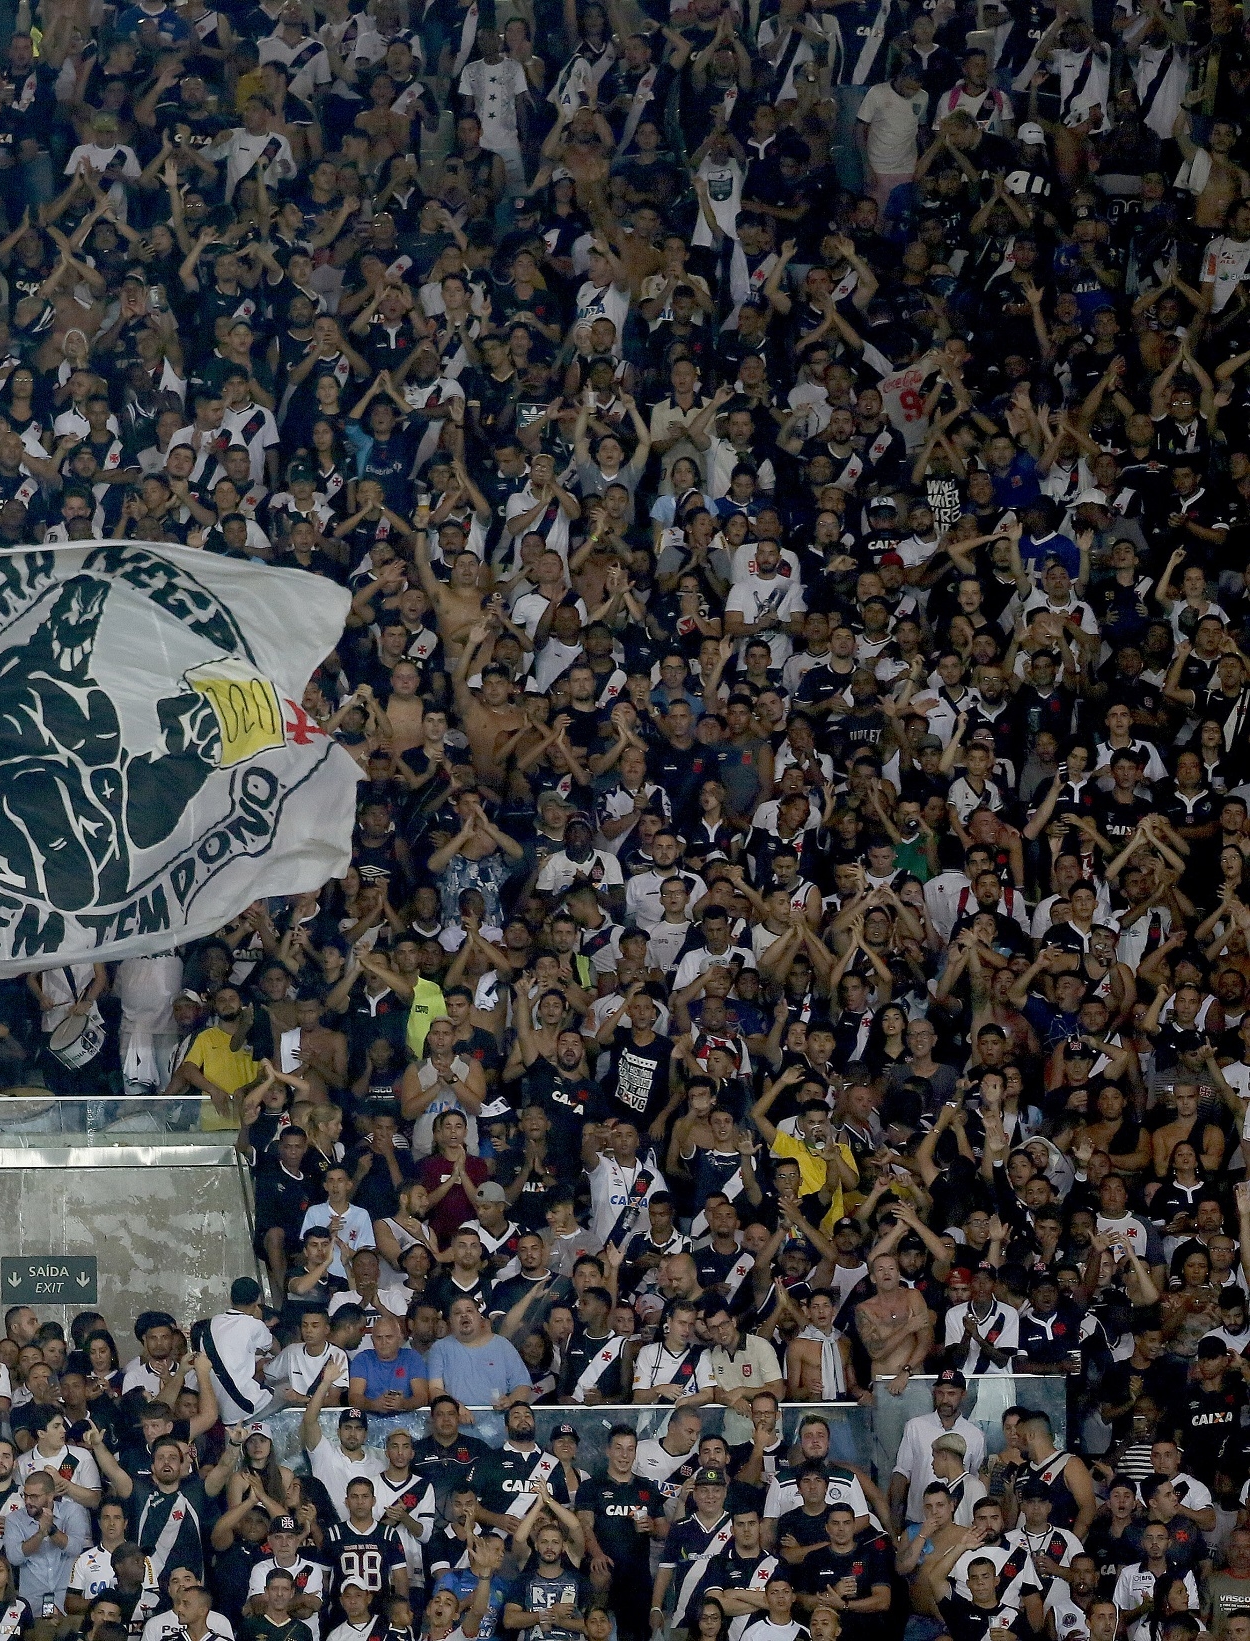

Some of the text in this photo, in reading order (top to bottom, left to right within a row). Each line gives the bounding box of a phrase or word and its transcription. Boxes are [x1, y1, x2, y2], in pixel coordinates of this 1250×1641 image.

[867, 540, 900, 550] CAIX
[75, 883, 170, 947] TEM
[170, 766, 281, 910] DONO
[29, 1262, 70, 1277] SAÍDA
[35, 1281, 64, 1294] EXIT
[1192, 1411, 1233, 1427] CAIXA
[341, 1552, 382, 1592] 98
